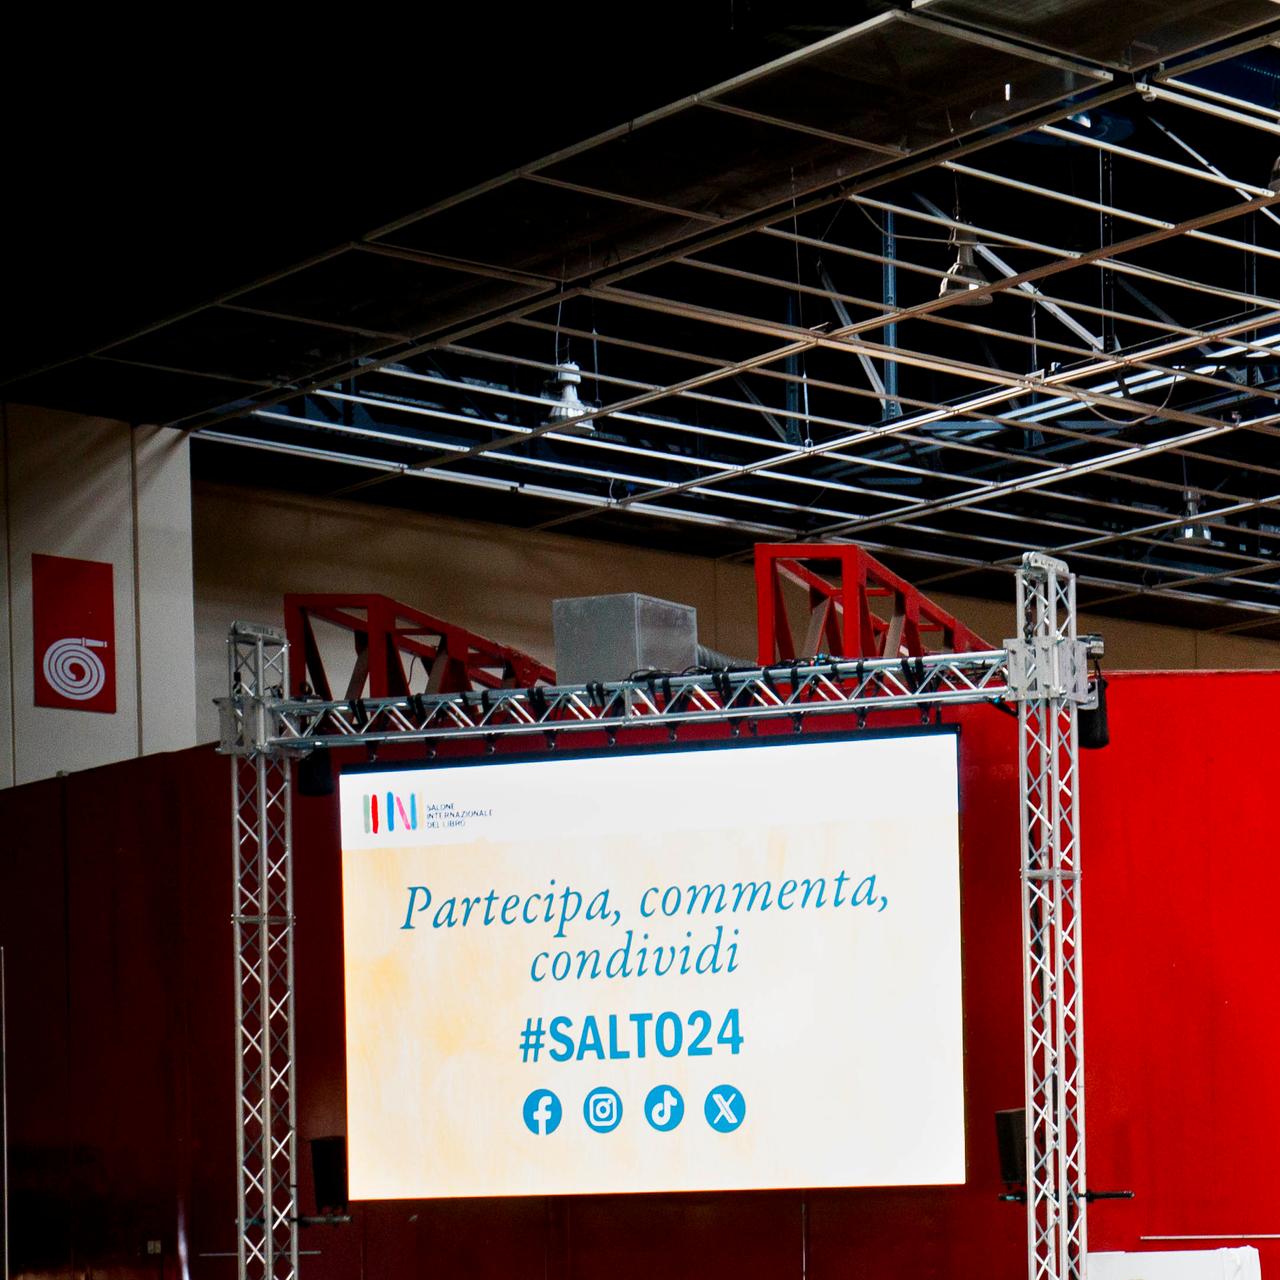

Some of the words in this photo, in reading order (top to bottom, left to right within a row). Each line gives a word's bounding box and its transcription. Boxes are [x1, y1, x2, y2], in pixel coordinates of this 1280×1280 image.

[399, 879, 623, 938] Partecipa,
[640, 869, 890, 920] commenta,
[531, 927, 741, 983] condividi
[519, 1008, 745, 1064] #SALTO24
